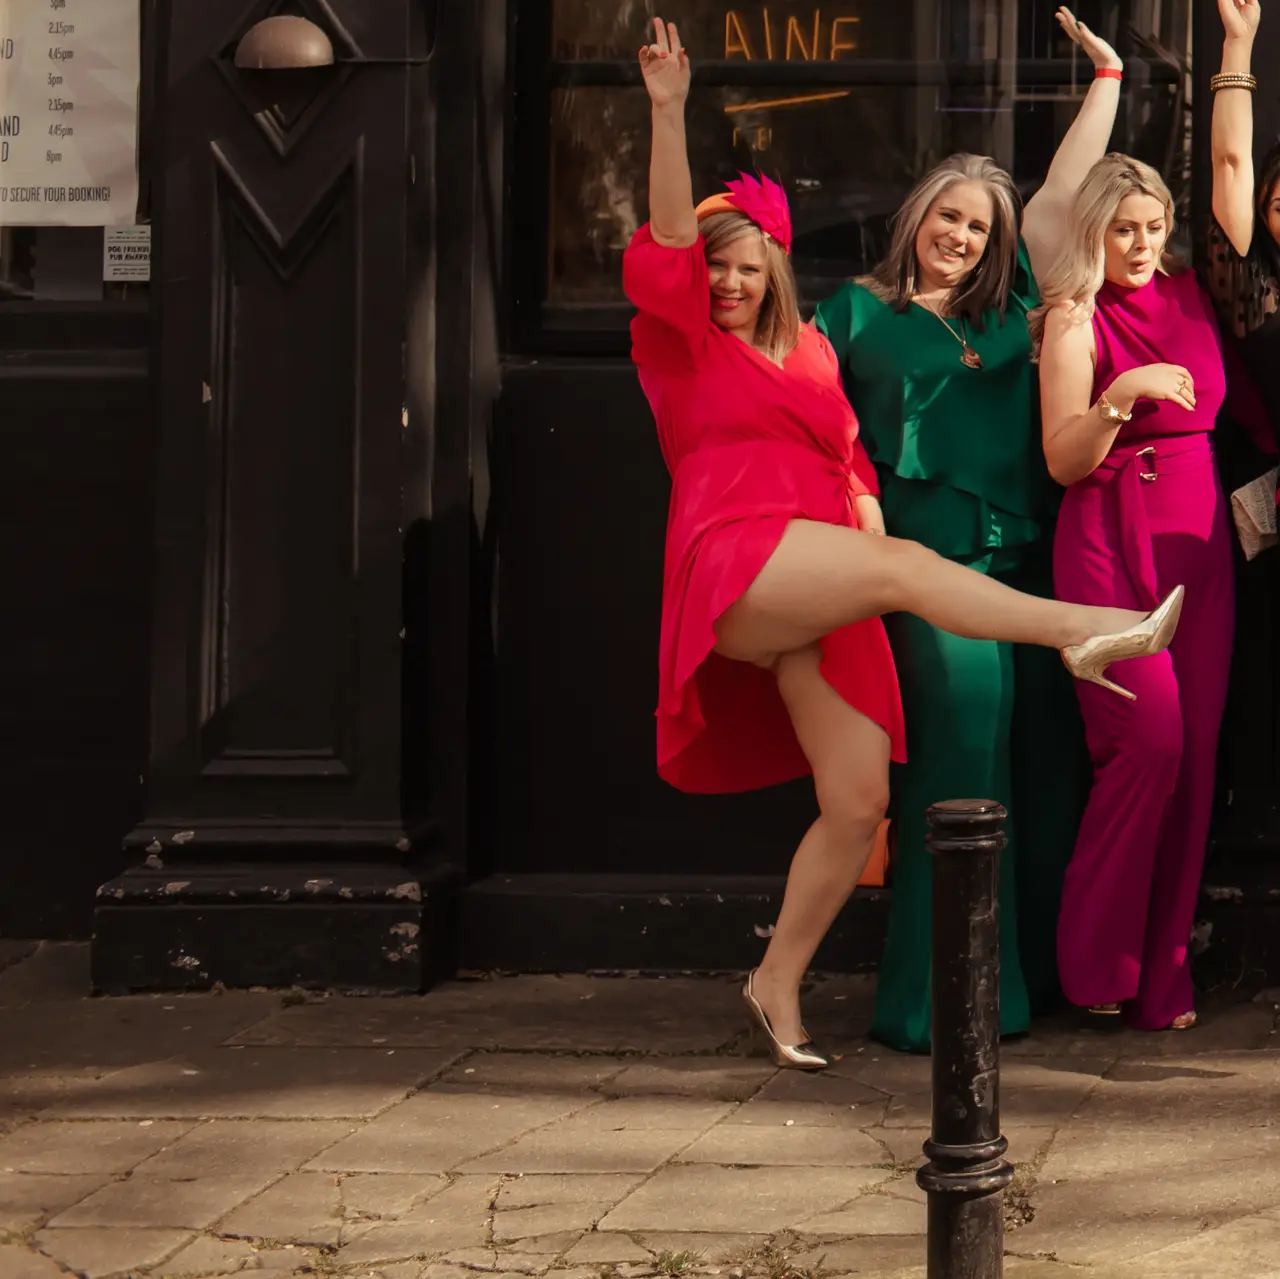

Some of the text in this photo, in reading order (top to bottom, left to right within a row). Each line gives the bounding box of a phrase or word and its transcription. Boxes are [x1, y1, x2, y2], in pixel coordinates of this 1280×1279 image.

[10, 187, 41, 202] SECURE
[43, 186, 66, 202] YOUR
[68, 186, 111, 202] BOOKING!
